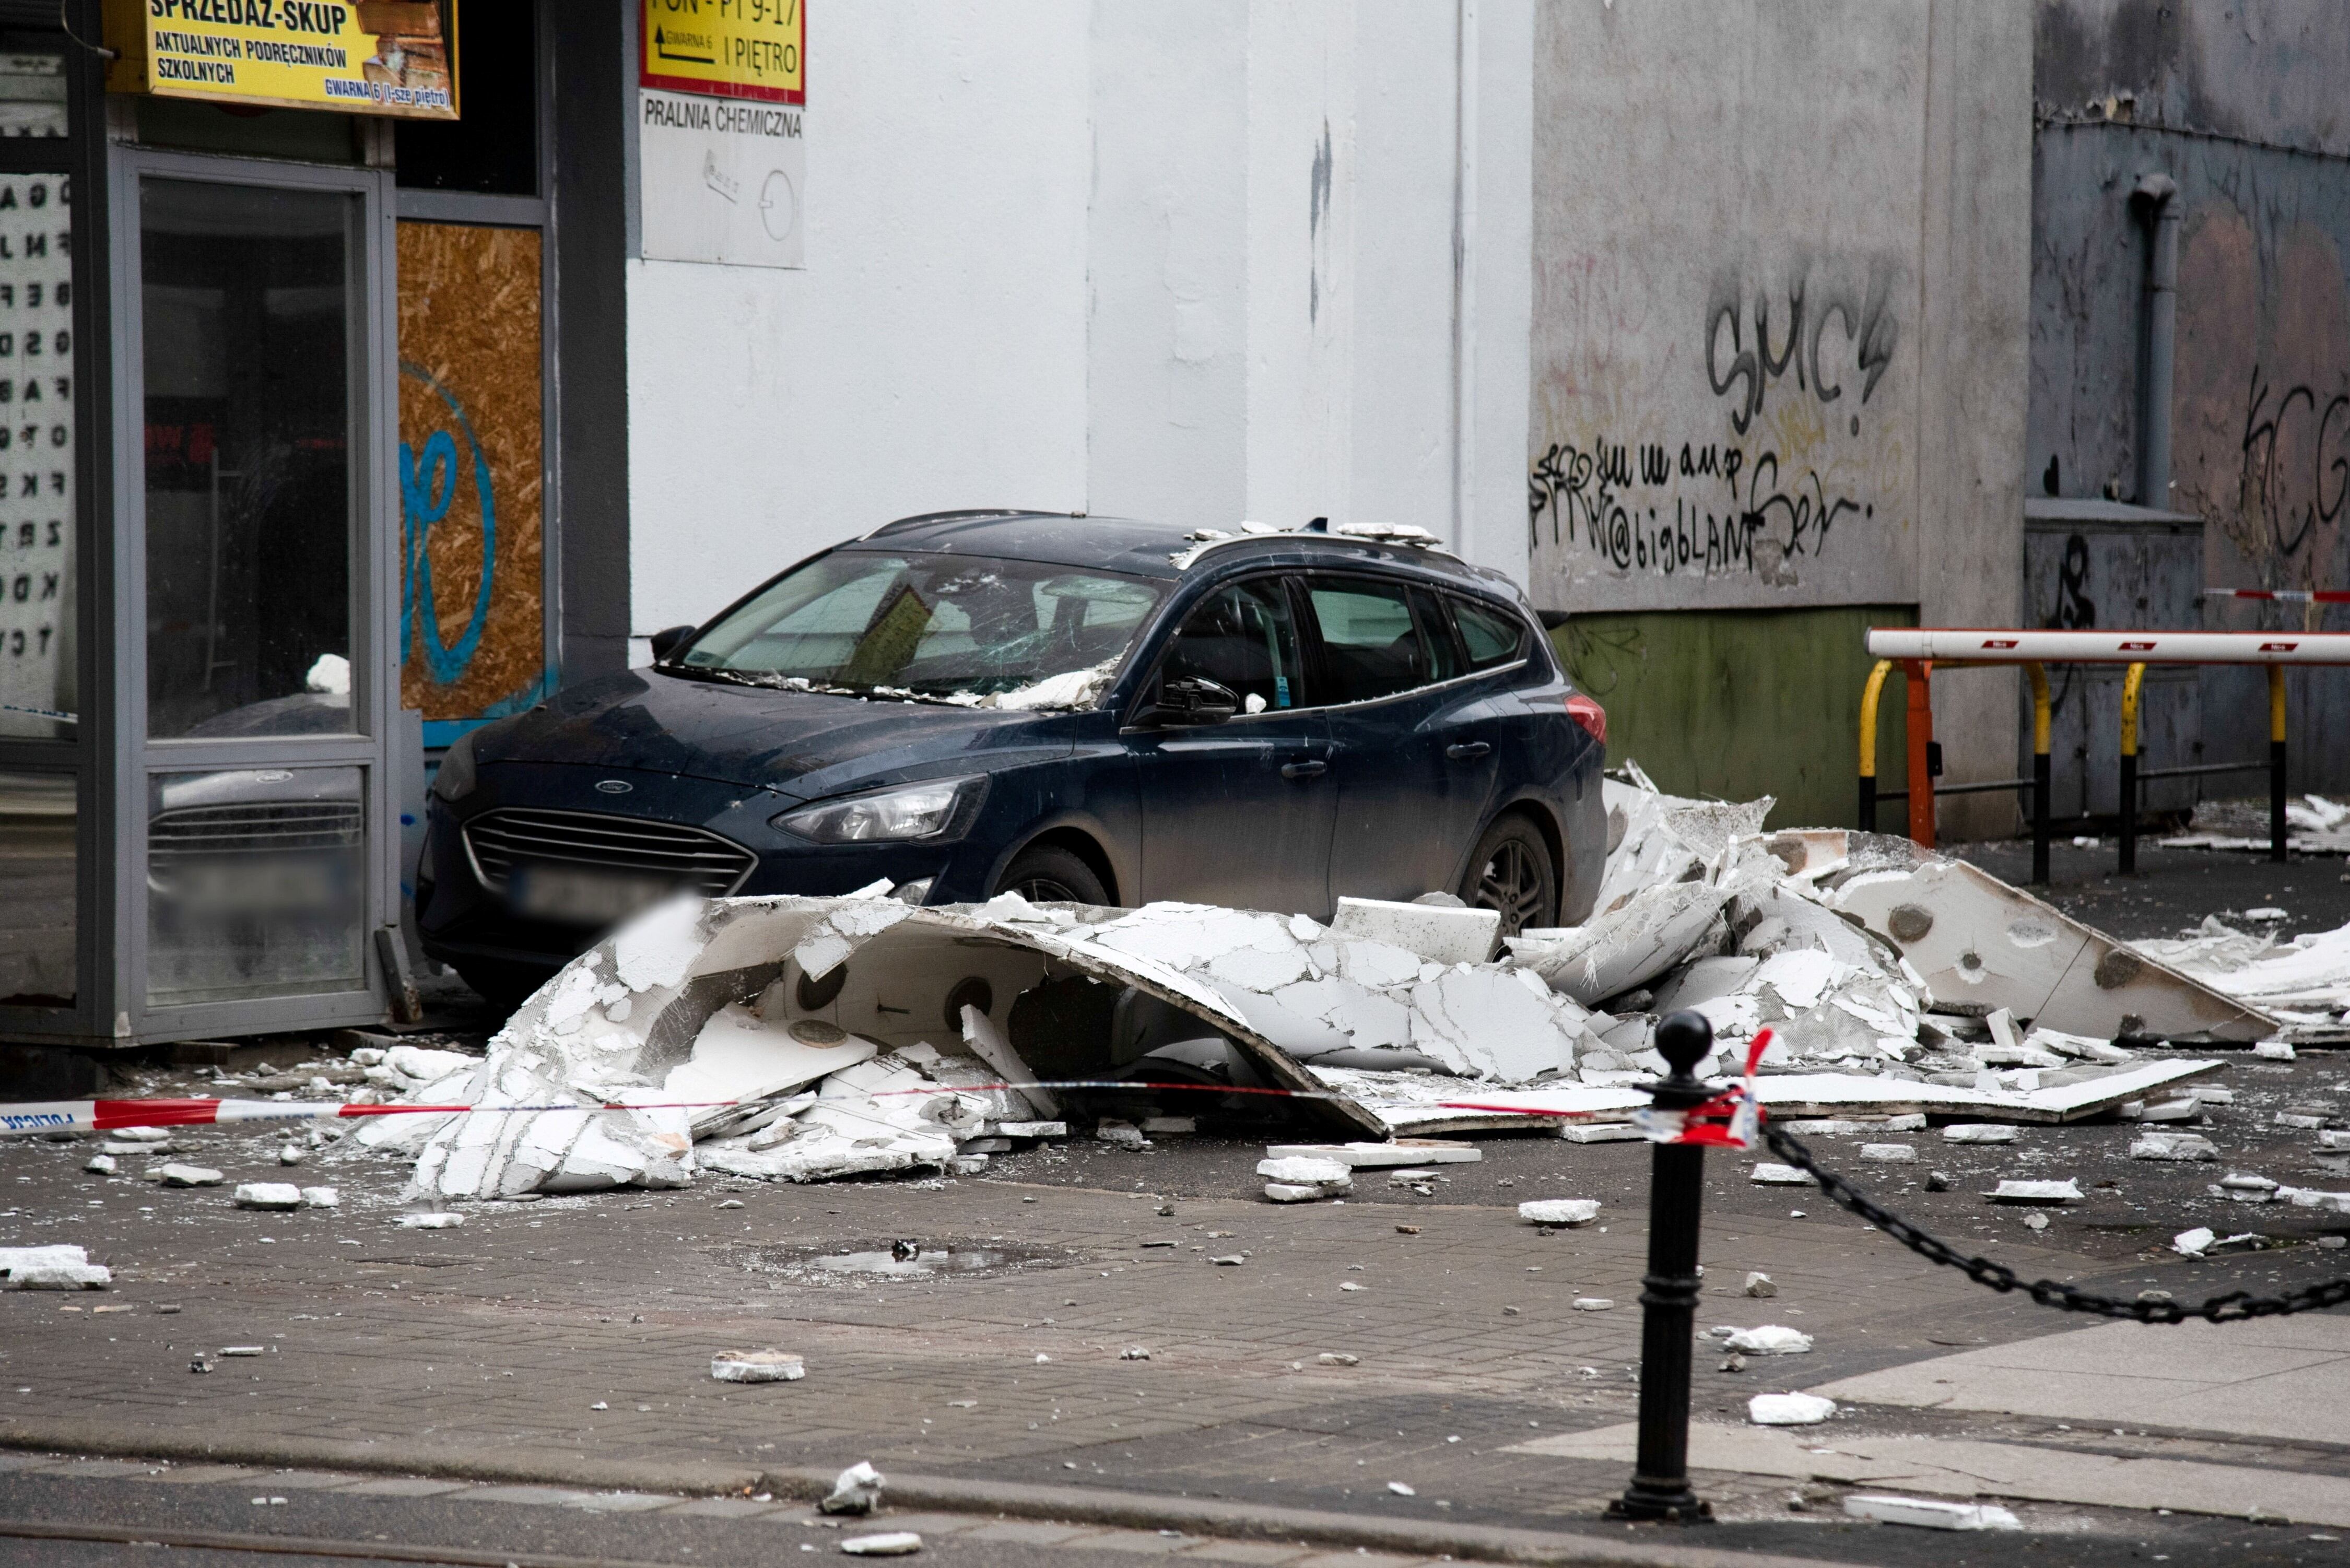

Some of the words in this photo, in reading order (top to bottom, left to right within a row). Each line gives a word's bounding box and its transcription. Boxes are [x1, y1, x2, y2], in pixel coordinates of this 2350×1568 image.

[156, 30, 242, 59] AKTUALNYCH
[245, 40, 347, 68] PODRĘCZNIKÓW
[735, 37, 797, 76] PIĘTRO
[158, 57, 235, 84] SZKOLNYCH
[325, 78, 372, 98] GWARNA
[373, 82, 381, 100] 6
[415, 88, 450, 109] piętro)
[645, 99, 711, 131] PRALNIA
[715, 105, 802, 139] CHEMICZNA
